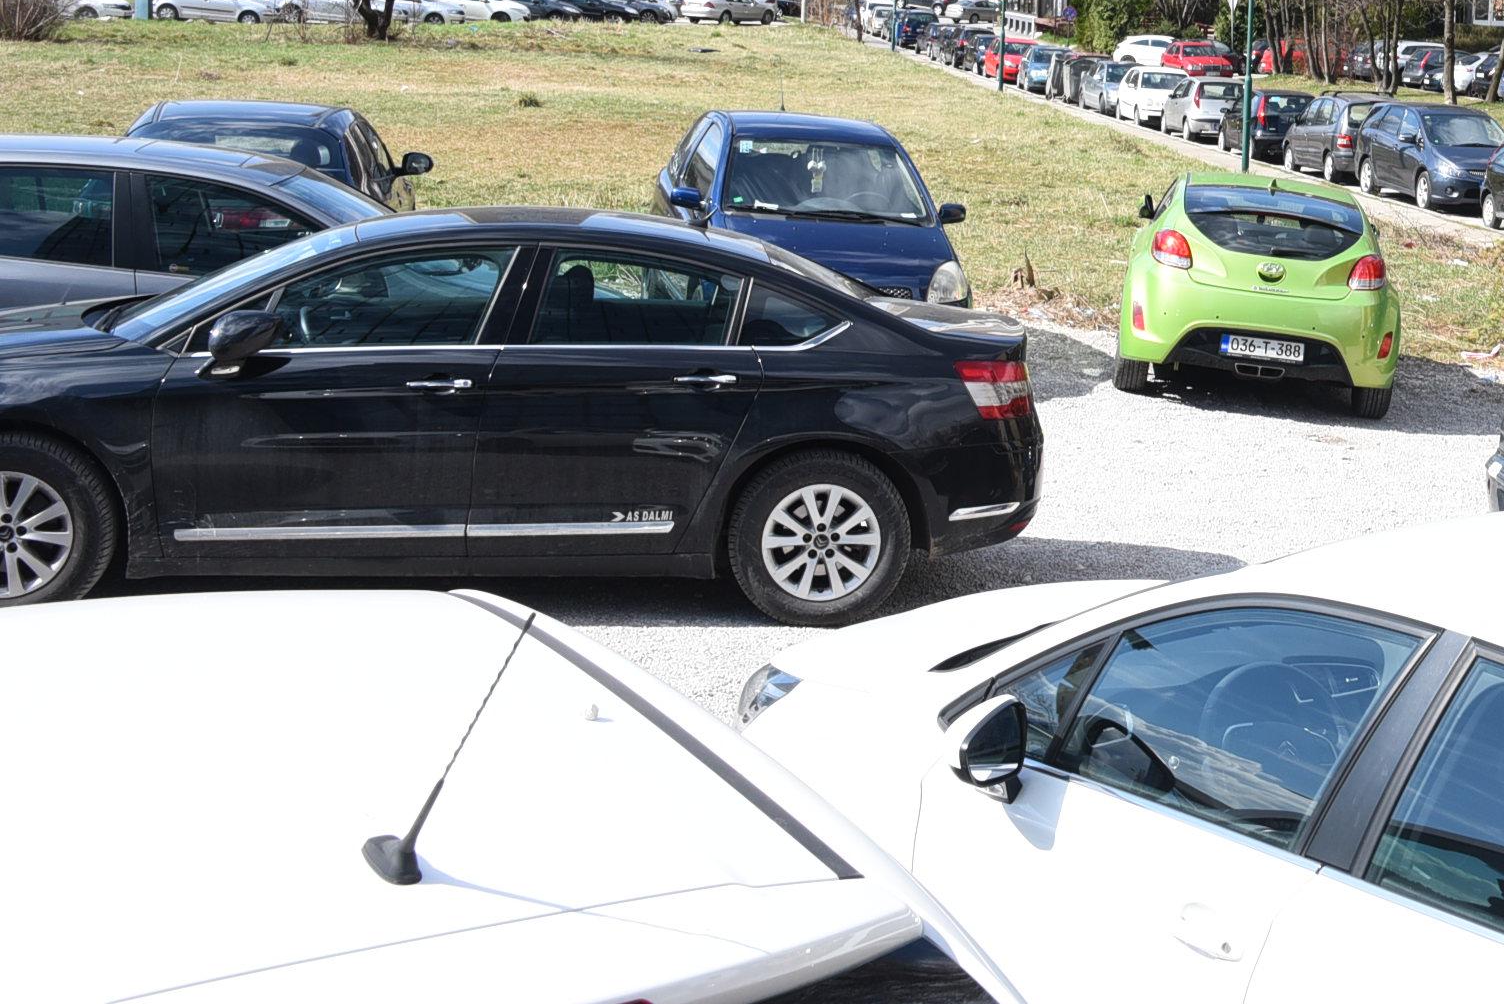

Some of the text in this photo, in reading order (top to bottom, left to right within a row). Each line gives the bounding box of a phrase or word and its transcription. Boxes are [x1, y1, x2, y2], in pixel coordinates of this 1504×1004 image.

[1231, 337, 1301, 359] 036-T-388
[625, 509, 674, 522] AS DALMI
